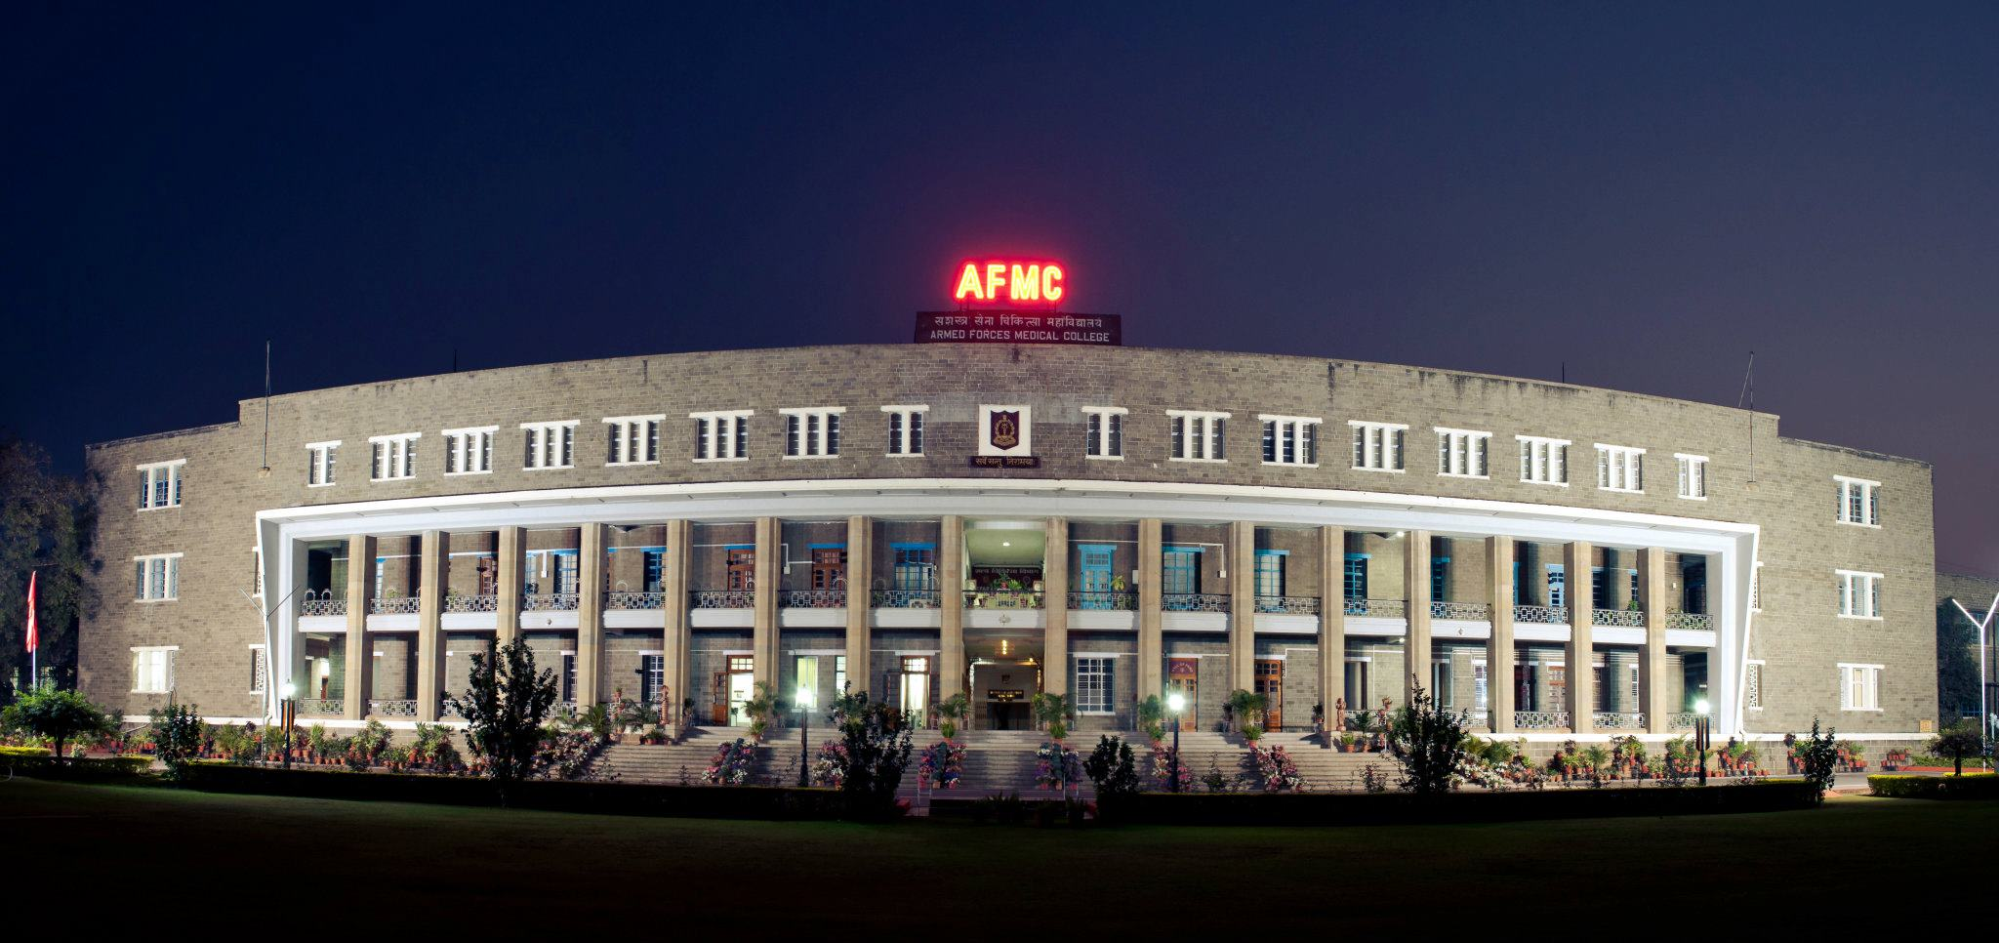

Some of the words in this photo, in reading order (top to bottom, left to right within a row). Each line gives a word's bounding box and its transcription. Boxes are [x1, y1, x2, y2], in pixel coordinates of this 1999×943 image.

[956, 264, 1063, 301] AFMC
[934, 316, 968, 326] सशस्त्र
[974, 313, 994, 326] सेना
[1000, 313, 1041, 327] चिकित्सा
[1046, 315, 1102, 328] महाविद्यालय
[930, 329, 966, 340] ARMED
[969, 330, 1011, 340] FORCES
[1014, 330, 1060, 341] MEDICAL
[1063, 331, 1110, 343] COLLEGE
